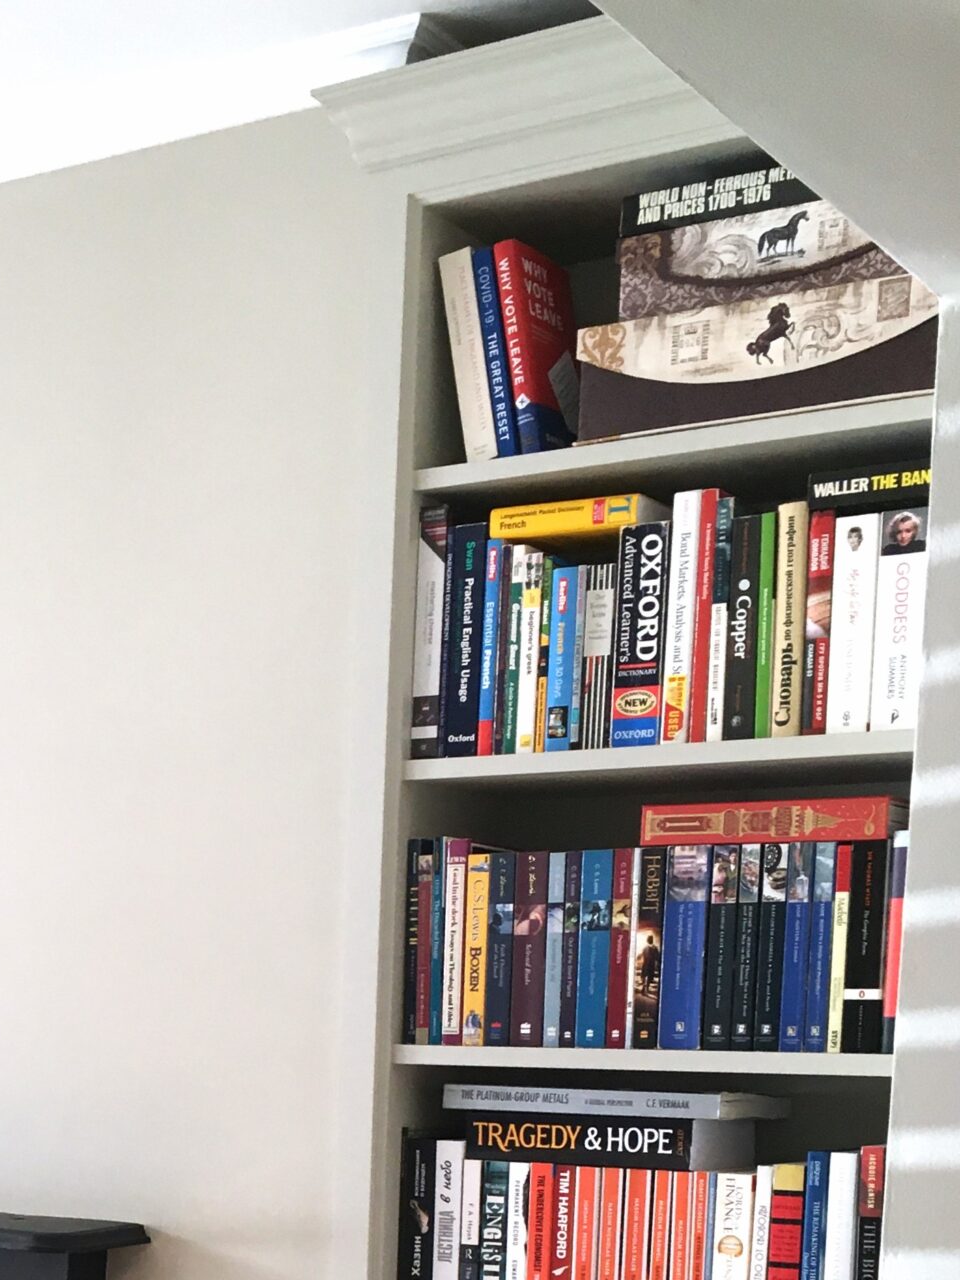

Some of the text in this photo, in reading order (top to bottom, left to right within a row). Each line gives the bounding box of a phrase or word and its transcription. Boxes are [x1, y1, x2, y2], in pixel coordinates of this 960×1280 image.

[637, 183, 772, 226] AND PRICES 1700-1976
[639, 187, 680, 209] WORLD
[682, 170, 766, 201] NON-FERROUS
[522, 256, 548, 281] WHY
[525, 279, 556, 308] VOTE
[499, 257, 526, 386] WHY VOTE LEAVE
[528, 298, 565, 331] LEAVE
[488, 332, 500, 357] THE
[491, 360, 506, 399] GREAT
[496, 403, 511, 441] RESET
[813, 477, 869, 499] WALLER
[871, 473, 899, 491] THE
[500, 520, 527, 531] French
[680, 532, 691, 559] Bond
[558, 579, 567, 614] Berlitz
[619, 536, 637, 663] Advanced Learner's
[636, 534, 662, 661] OXFORD
[892, 562, 911, 644] GODDESS
[458, 541, 476, 703] Swan Practical English Usage
[509, 603, 520, 670] Grammar Smart
[556, 622, 566, 655] French
[673, 602, 687, 641] Analysis
[730, 595, 752, 658] Copper
[774, 515, 797, 727] Словарь по физической географии
[481, 602, 495, 689] Essential French
[525, 611, 535, 675] beginner's greek
[673, 644, 683, 663] and
[618, 669, 656, 677] DICTIONARY
[886, 657, 897, 699] SUMMERS
[898, 654, 907, 699] ANTHONY
[624, 698, 648, 707] NEW
[448, 734, 475, 743] Oxford
[614, 729, 655, 740] OXFORD
[668, 710, 681, 737] USED
[446, 963, 456, 993] Theology
[469, 946, 482, 992] BOXEN
[461, 1089, 570, 1105] THE PLATINUM-GROUP METALS
[473, 1121, 582, 1152] TRAGEDY
[584, 1127, 603, 1150] &
[607, 1127, 674, 1155] HOPE
[537, 1175, 546, 1187] THE
[559, 1170, 570, 1194] TIM
[867, 1153, 877, 1181] JACQUIE
[436, 1160, 456, 1263] ЛЕСТНИЦА в небо
[513, 1180, 521, 1218] PERMANENT
[534, 1188, 545, 1232] UNDERCOVER
[722, 1178, 736, 1233] FINANCE
[813, 1202, 821, 1216] THE
[556, 1196, 569, 1259] HARFORD
[756, 1204, 767, 1246] СВОБОДЫ
[811, 1217, 820, 1254] REMAKING
[863, 1222, 878, 1254] THE
[411, 1235, 422, 1277] Хазин
[533, 1233, 544, 1272] ECONOMIST
[754, 1249, 764, 1261] ОТ
[811, 1256, 817, 1266] OF
